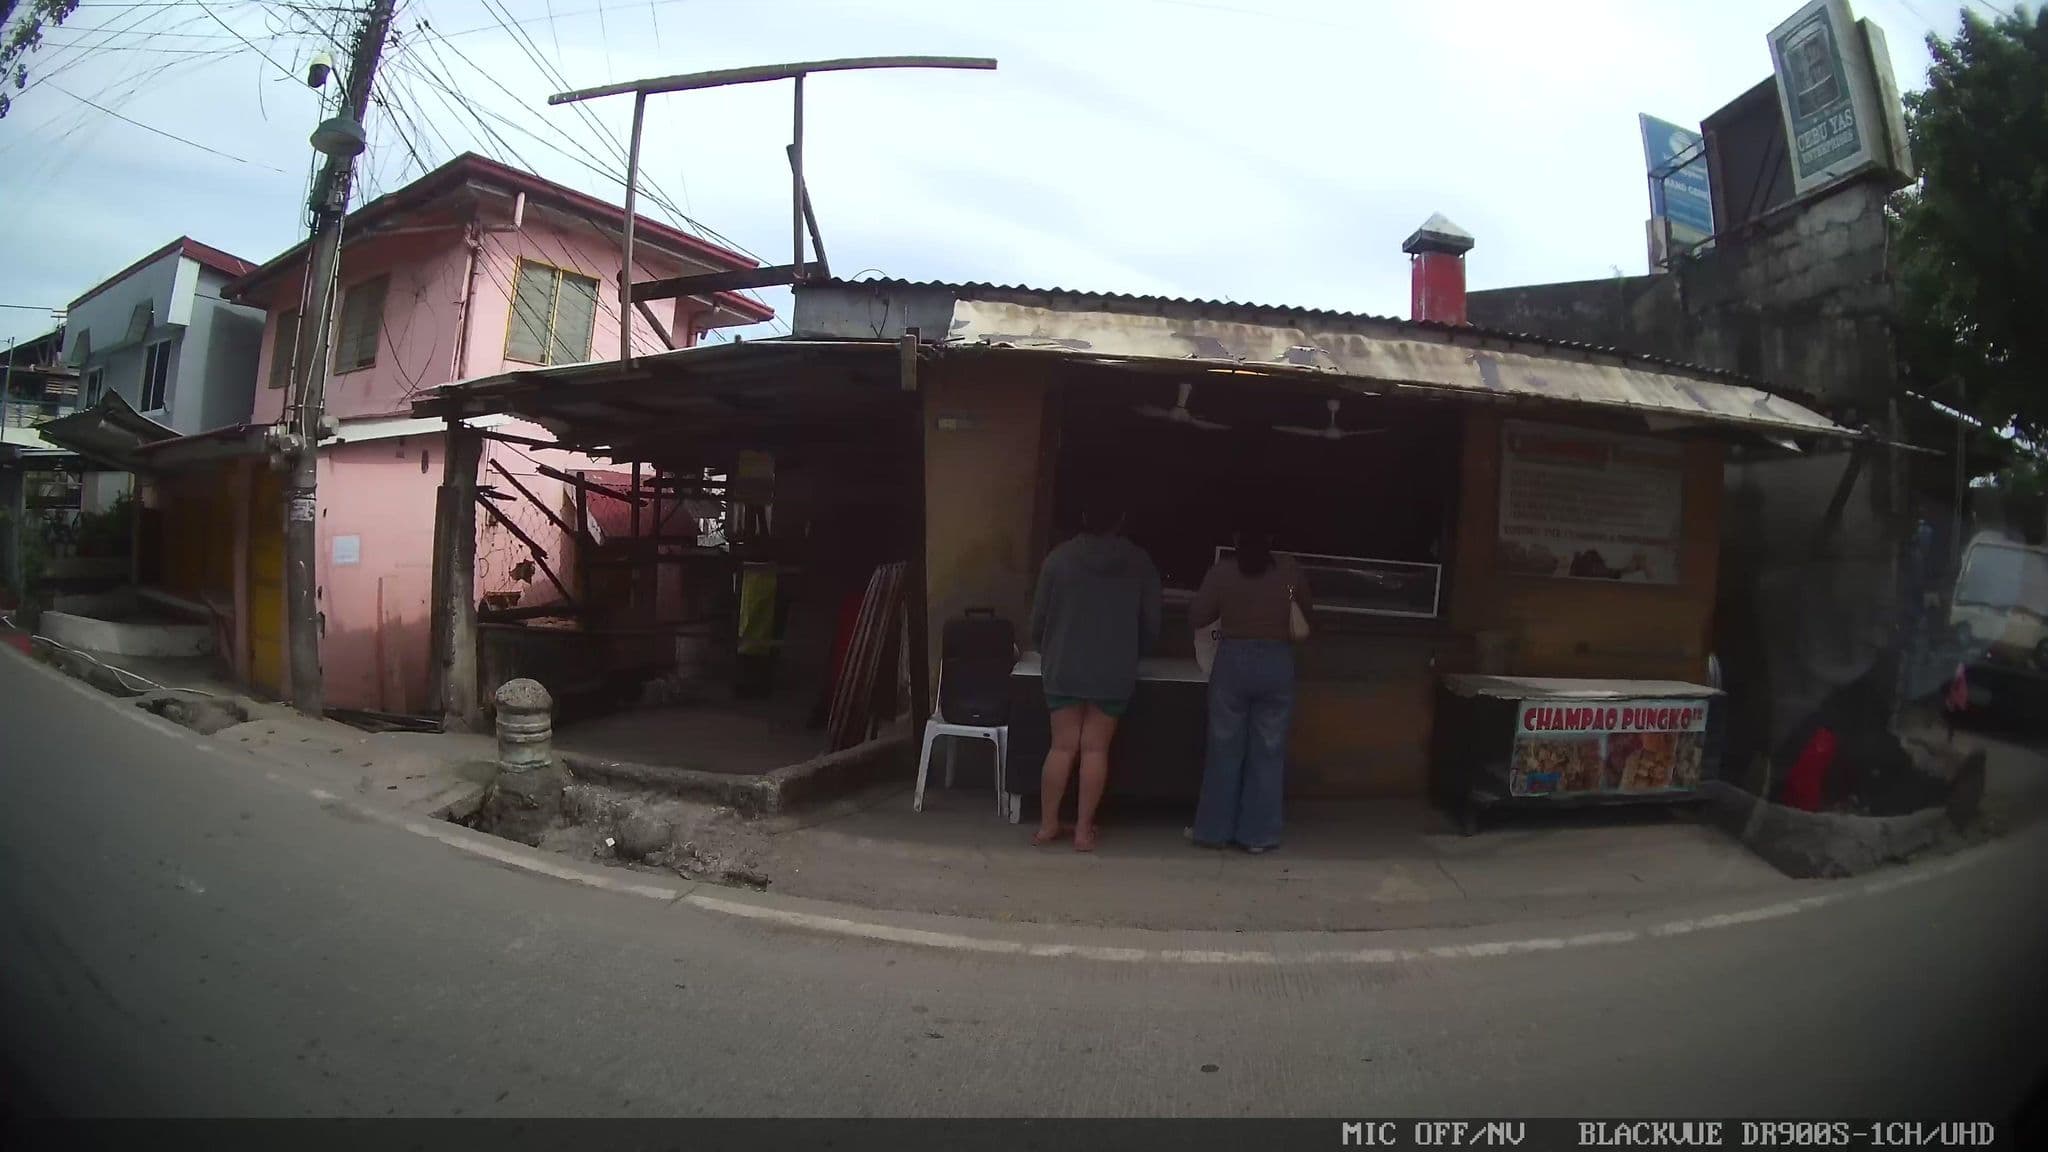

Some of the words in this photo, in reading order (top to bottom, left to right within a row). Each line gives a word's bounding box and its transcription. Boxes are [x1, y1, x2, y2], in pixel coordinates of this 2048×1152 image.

[1797, 121, 1828, 152] CEBU
[1829, 108, 1853, 134] YAS
[1524, 707, 1618, 732] CHAMPAO
[1621, 707, 1692, 730] PUNGKO
